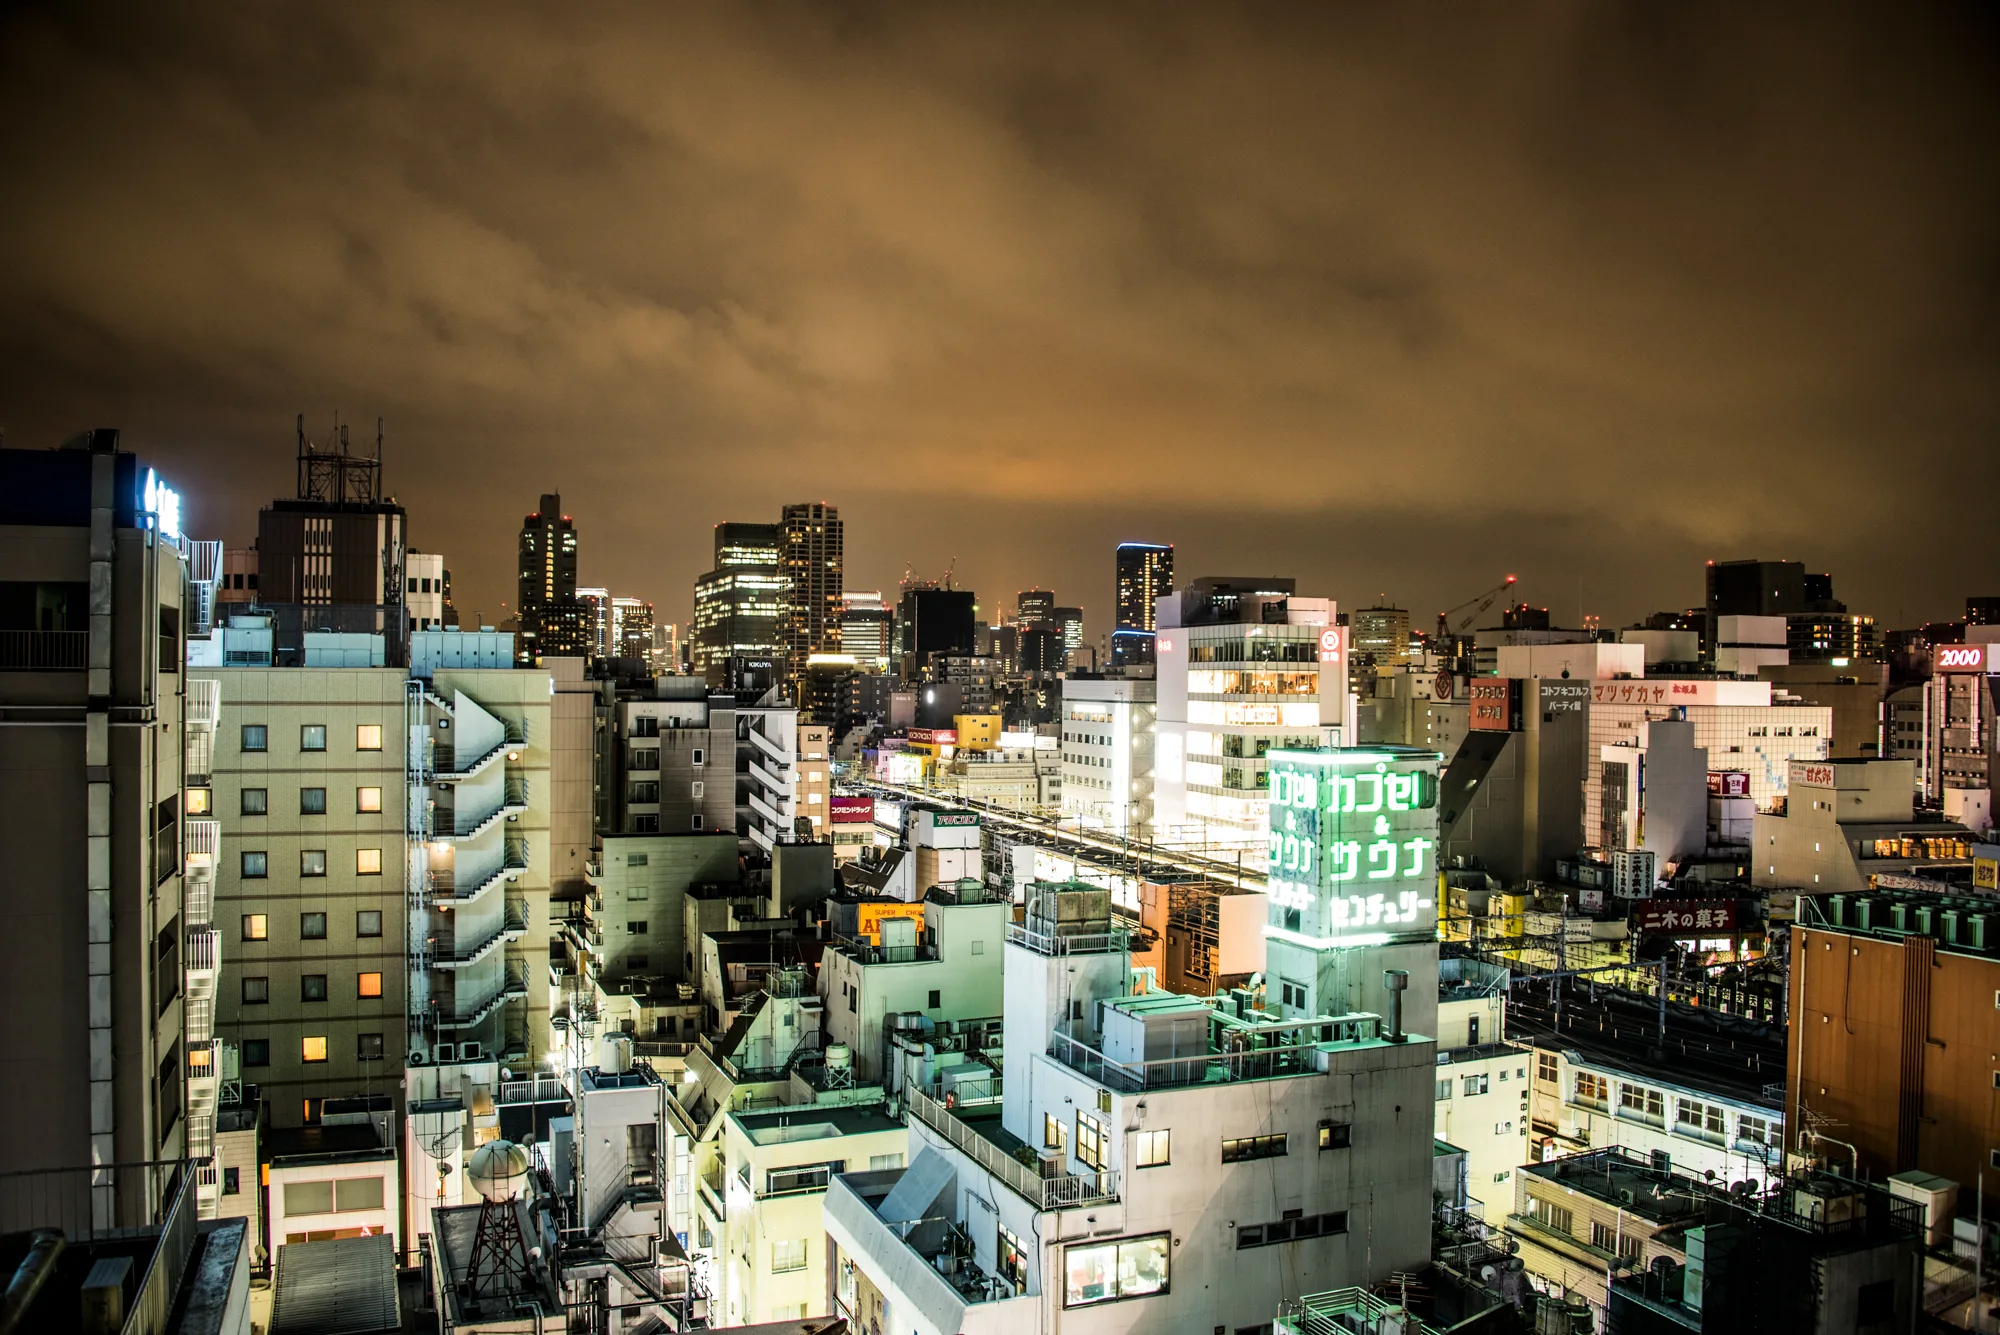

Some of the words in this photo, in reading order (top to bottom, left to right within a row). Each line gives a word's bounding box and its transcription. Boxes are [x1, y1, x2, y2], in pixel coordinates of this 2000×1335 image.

[1940, 649, 1980, 666] 2000
[1471, 686, 1506, 699] コトブキゴルフ
[1540, 686, 1589, 697] コトブキゴルフ
[1594, 685, 1665, 703] マツザカヤ
[1672, 683, 1698, 695] 松坂屋
[1257, 743, 1270, 751] GU
[1805, 766, 1832, 785] 甘太郎
[1269, 763, 1317, 810] カプセル
[1326, 762, 1436, 813] カプセル
[831, 806, 872, 814] コクミンドラッグ
[1285, 810, 1296, 831] &
[1373, 814, 1390, 835] &
[1269, 830, 1316, 873] サウナ
[1329, 836, 1433, 881] サウナ
[1631, 855, 1643, 897] 二木の菓子
[1330, 890, 1432, 928] センチュリー
[1644, 908, 1730, 929] 二木の菓子
